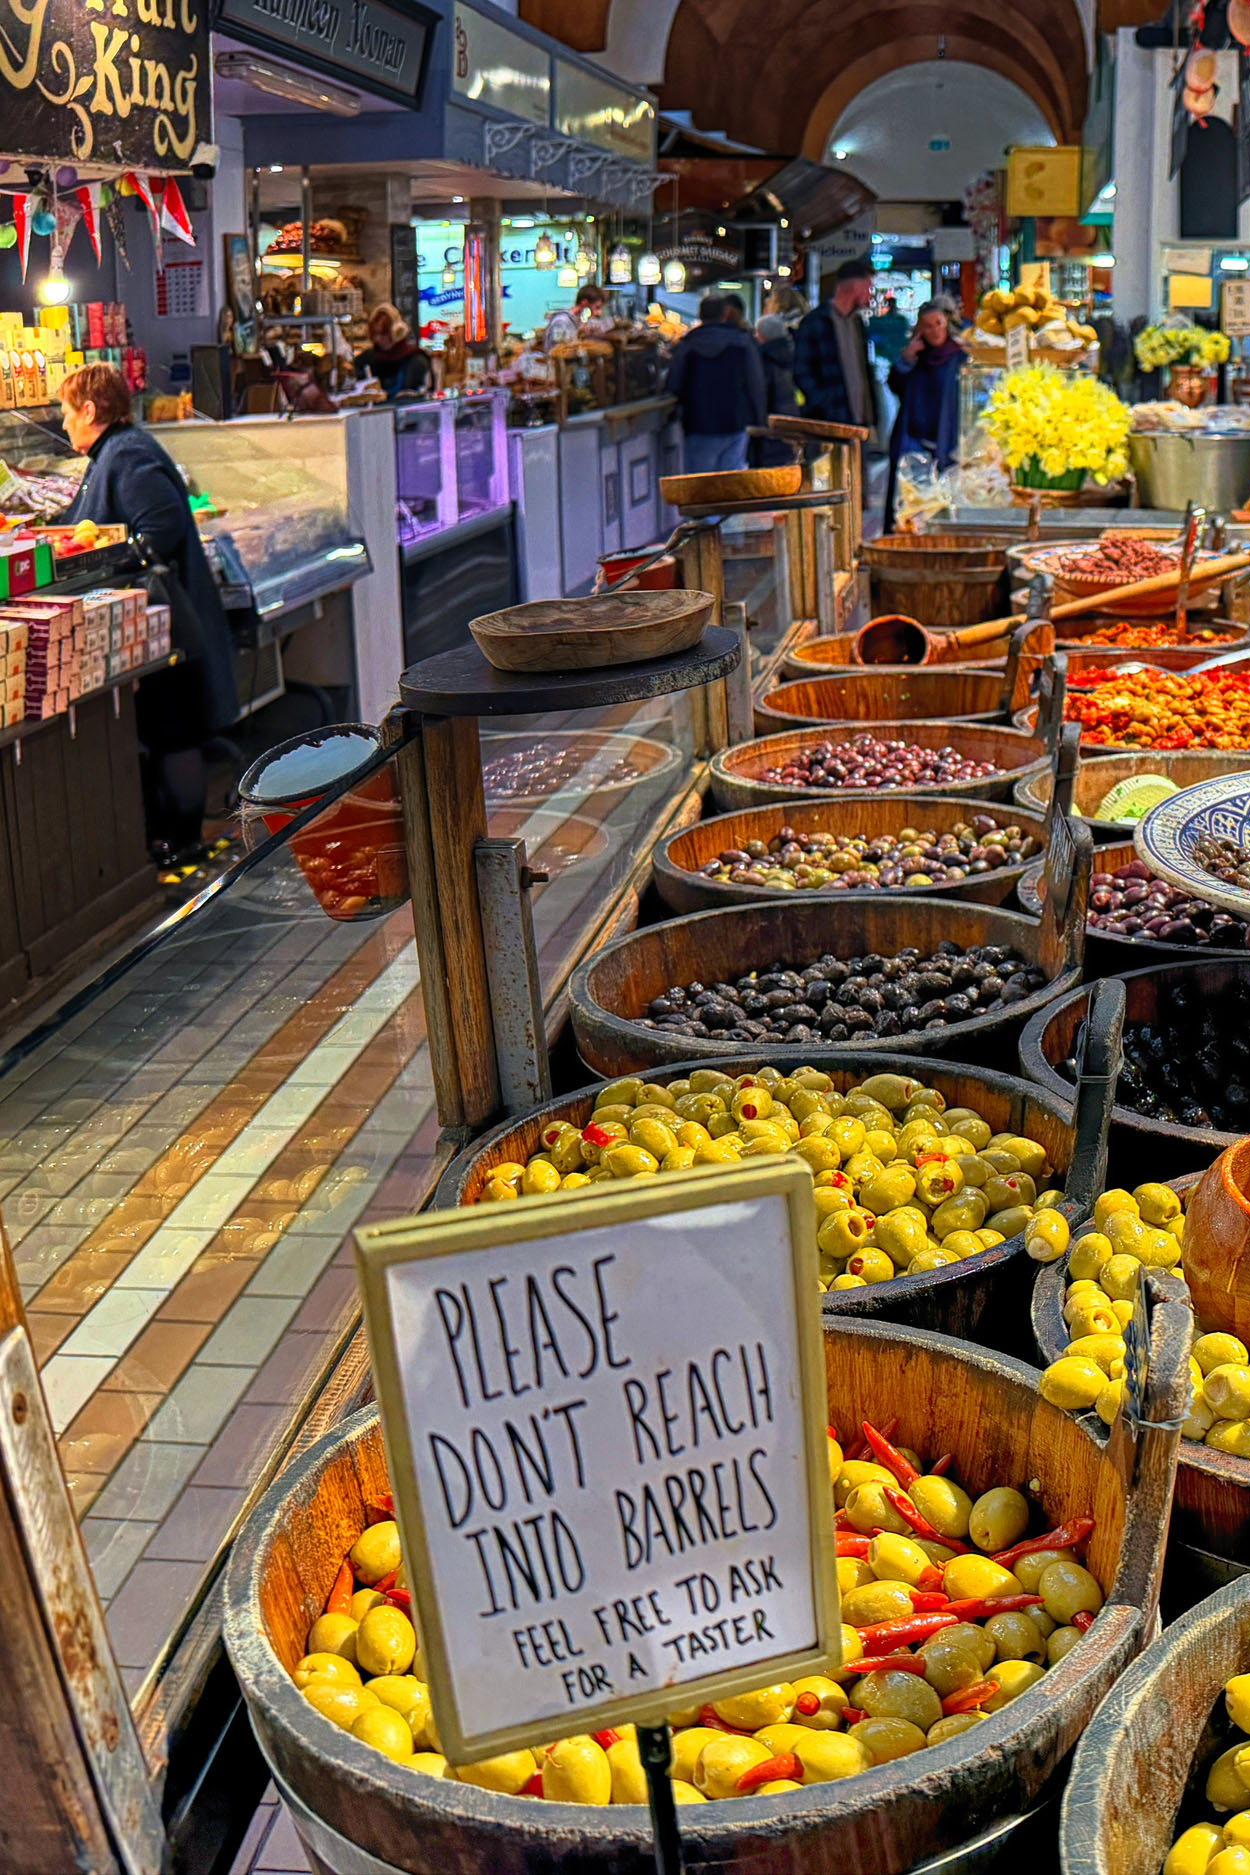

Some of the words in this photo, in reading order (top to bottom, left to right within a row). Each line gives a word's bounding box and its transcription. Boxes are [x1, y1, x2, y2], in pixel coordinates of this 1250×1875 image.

[89, 20, 198, 160] King
[434, 1254, 631, 1409] PLEASE
[429, 1400, 588, 1529] DON'T
[623, 1342, 774, 1464] REACH
[465, 1509, 587, 1619] INTO
[615, 1448, 778, 1571] BARRELS
[512, 1620, 584, 1669] FEEL
[593, 1590, 671, 1647] FREE
[674, 1573, 720, 1616] TO
[729, 1555, 784, 1597] ASK
[561, 1662, 613, 1704] FOR
[629, 1651, 649, 1679] A
[662, 1609, 774, 1665] TASTER
